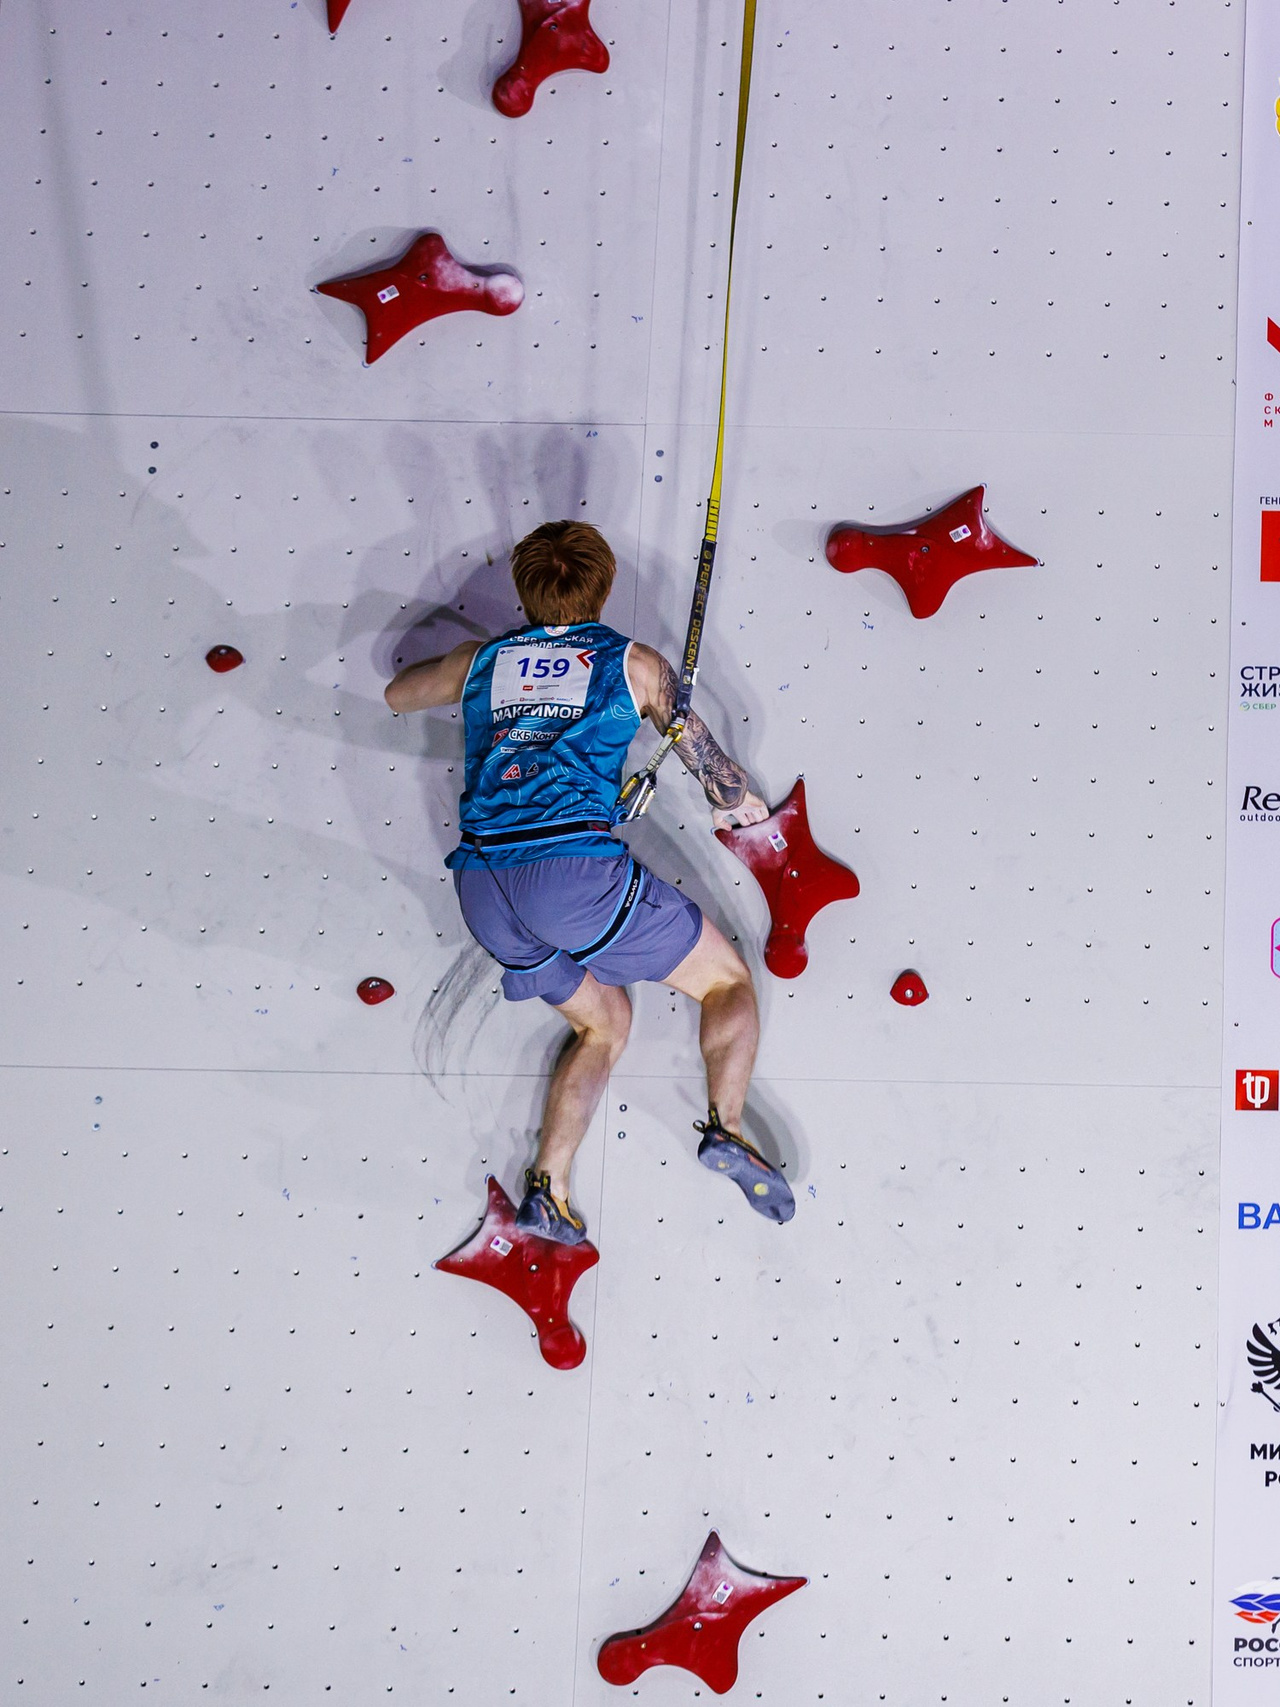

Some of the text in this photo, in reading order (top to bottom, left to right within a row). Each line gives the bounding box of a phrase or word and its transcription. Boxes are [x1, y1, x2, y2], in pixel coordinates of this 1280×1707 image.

[685, 562, 711, 671] PERFECT DESCENT
[517, 657, 570, 679] 159
[492, 705, 584, 724] МАКСИМОВ
[509, 728, 532, 742] СКБ
